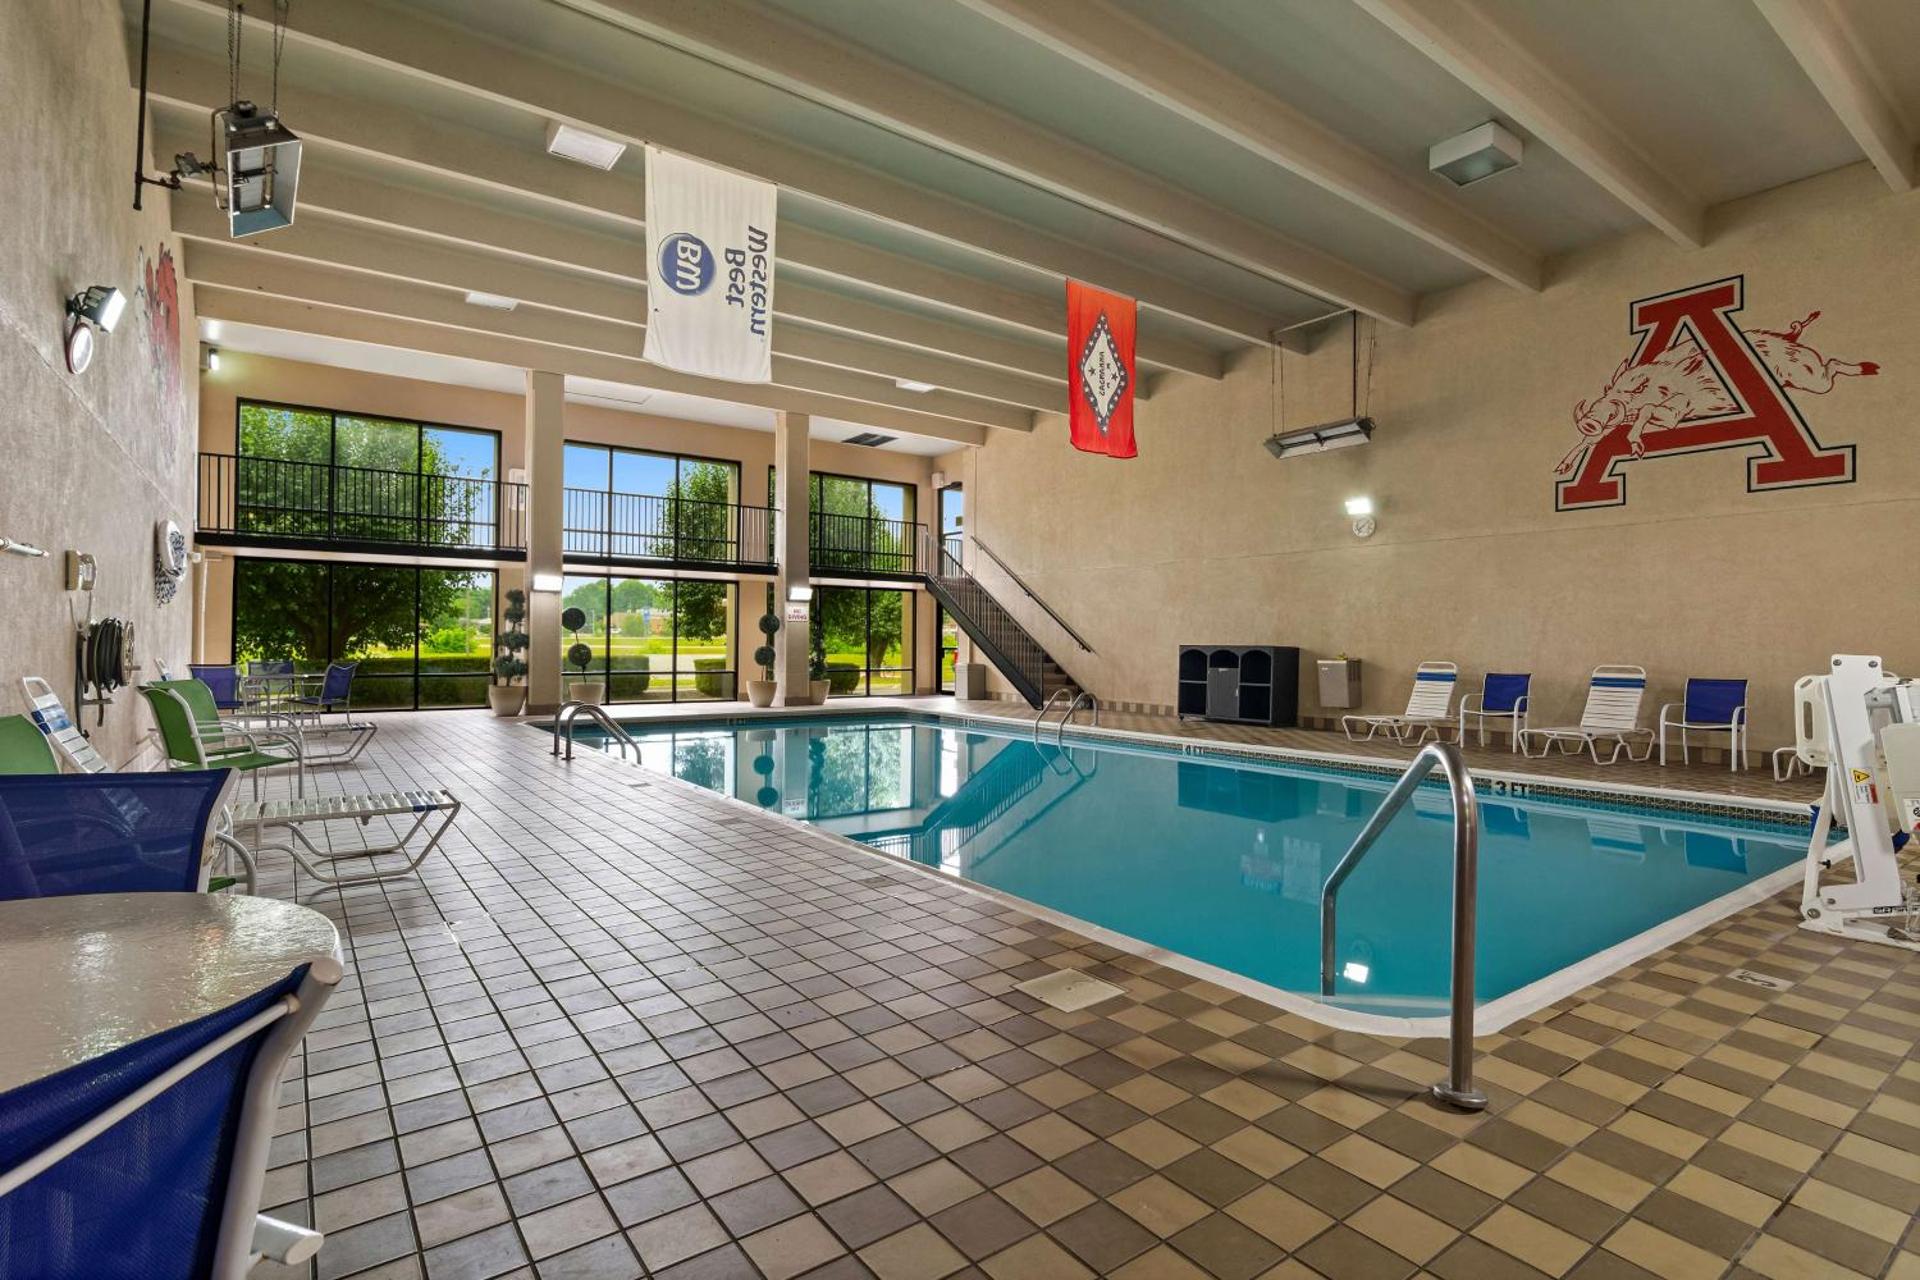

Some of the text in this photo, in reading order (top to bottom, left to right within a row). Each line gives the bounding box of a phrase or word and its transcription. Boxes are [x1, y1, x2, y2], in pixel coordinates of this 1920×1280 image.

[1555, 274, 1857, 512] A
[1495, 780, 1528, 795] 3 FT
